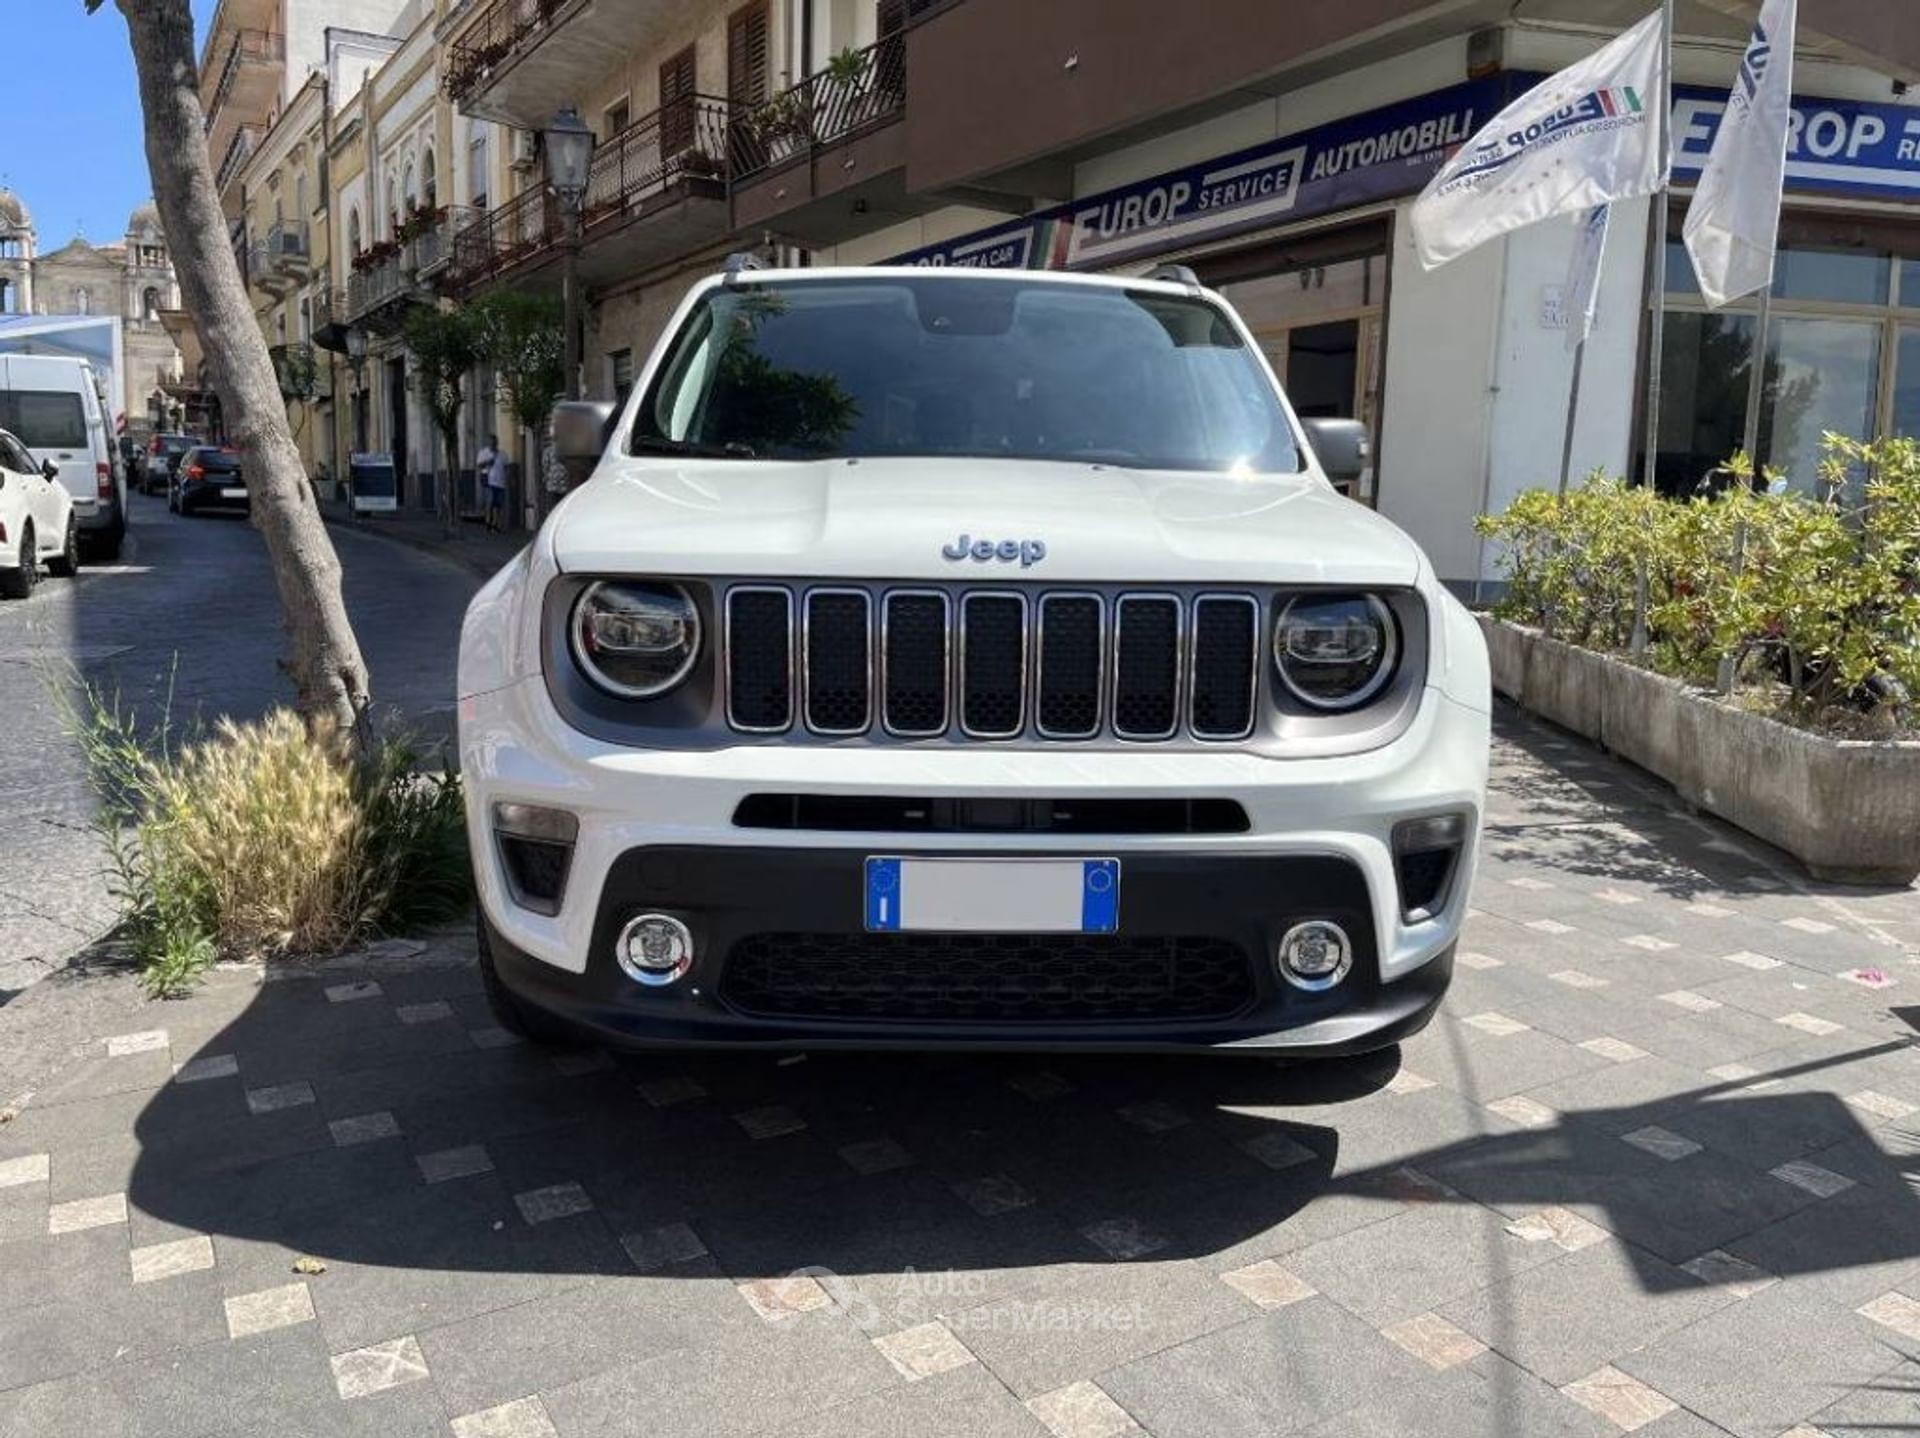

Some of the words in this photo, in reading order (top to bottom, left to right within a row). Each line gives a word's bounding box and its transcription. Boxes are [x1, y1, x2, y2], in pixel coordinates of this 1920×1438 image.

[1671, 98, 1886, 167] EROP
[1068, 181, 1191, 258] EUROP
[1199, 168, 1288, 210] SERVICE
[1310, 109, 1474, 181] AUTOMOBILI
[989, 246, 1015, 266] CAR
[942, 534, 1047, 568] Jeep
